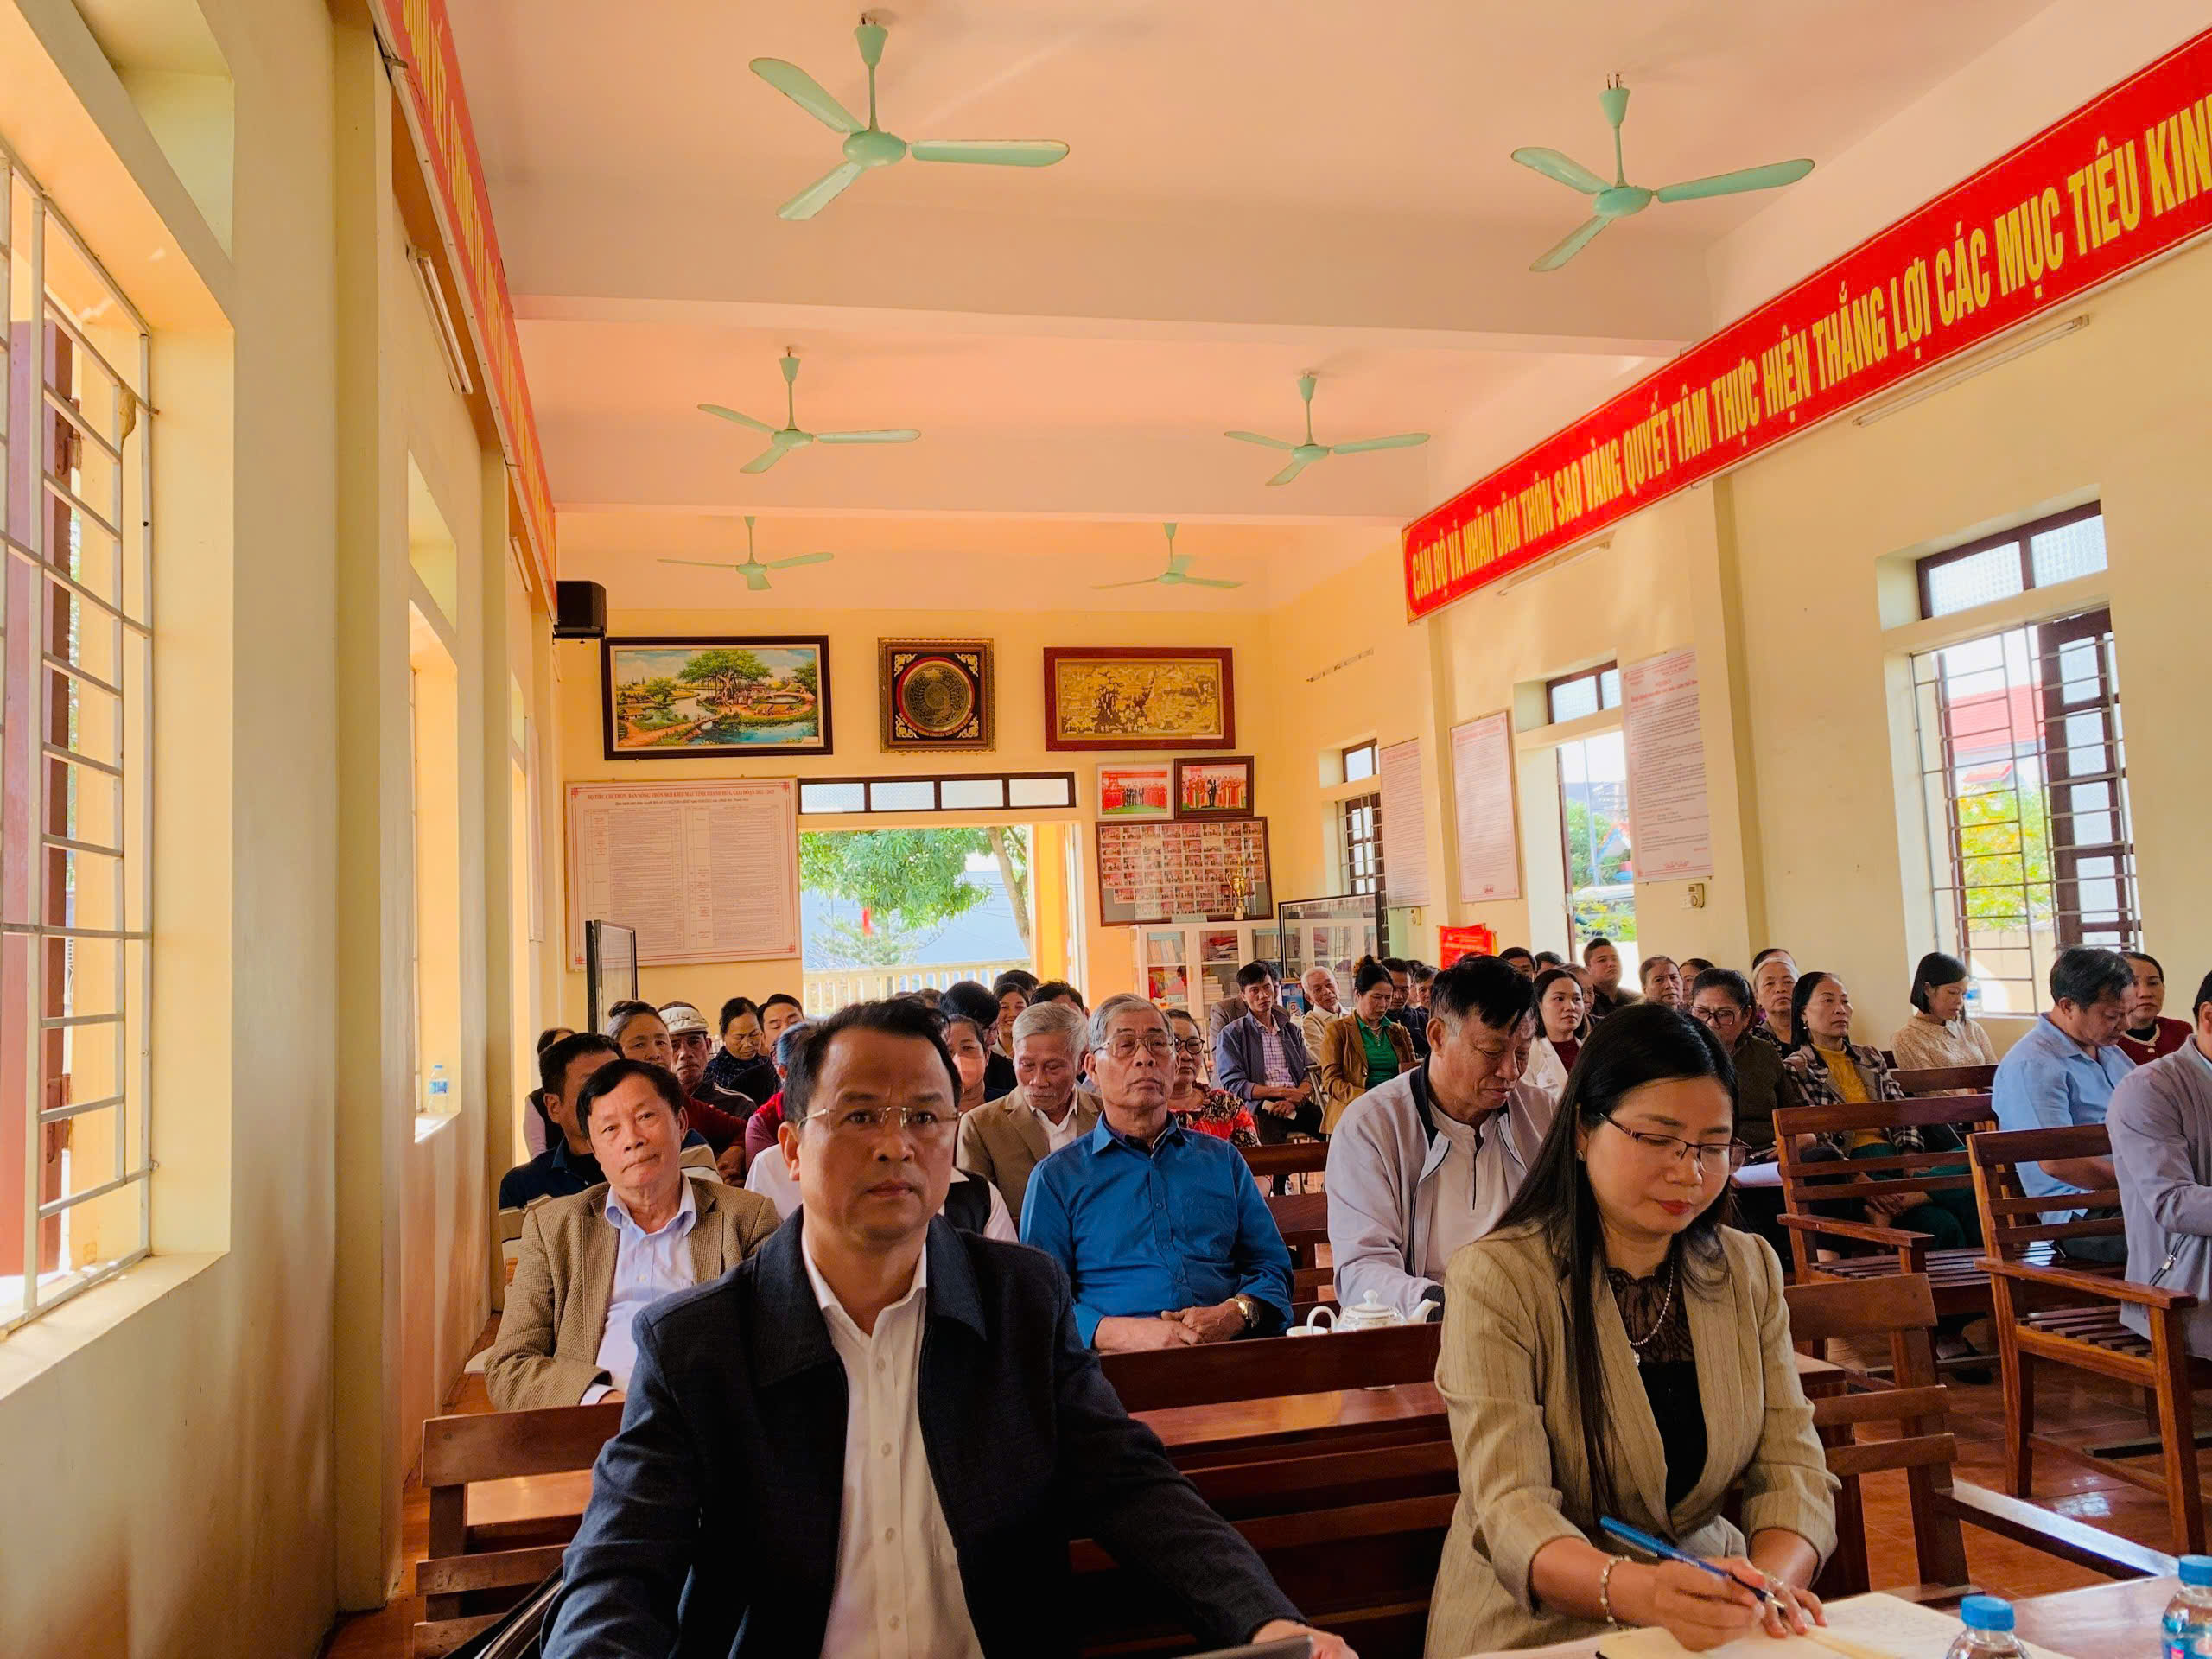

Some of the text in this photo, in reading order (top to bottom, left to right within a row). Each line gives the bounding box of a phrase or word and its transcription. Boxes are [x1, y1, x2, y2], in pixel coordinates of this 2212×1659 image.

[1412, 541, 1433, 601] CÁN
[1433, 527, 1448, 597] BỘ
[1447, 519, 1465, 582] VÀ
[1462, 505, 1495, 575] NHÂN
[1494, 490, 1521, 558] DÂN
[1520, 470, 1554, 545] THÔN
[1554, 460, 1582, 526] SAO
[1581, 437, 1623, 512] VÀNG
[1623, 390, 1670, 497] QUYẾT
[1672, 384, 1712, 464] TÂM
[1712, 357, 1760, 447] THỰC
[1761, 324, 1812, 423] HIỆN
[1812, 281, 1888, 391] THẮNG
[1890, 254, 1932, 360] LỢI
[1936, 221, 1991, 326] CÁC
[1994, 187, 2064, 299] MỤC
[2068, 136, 2141, 257] TIÊU
